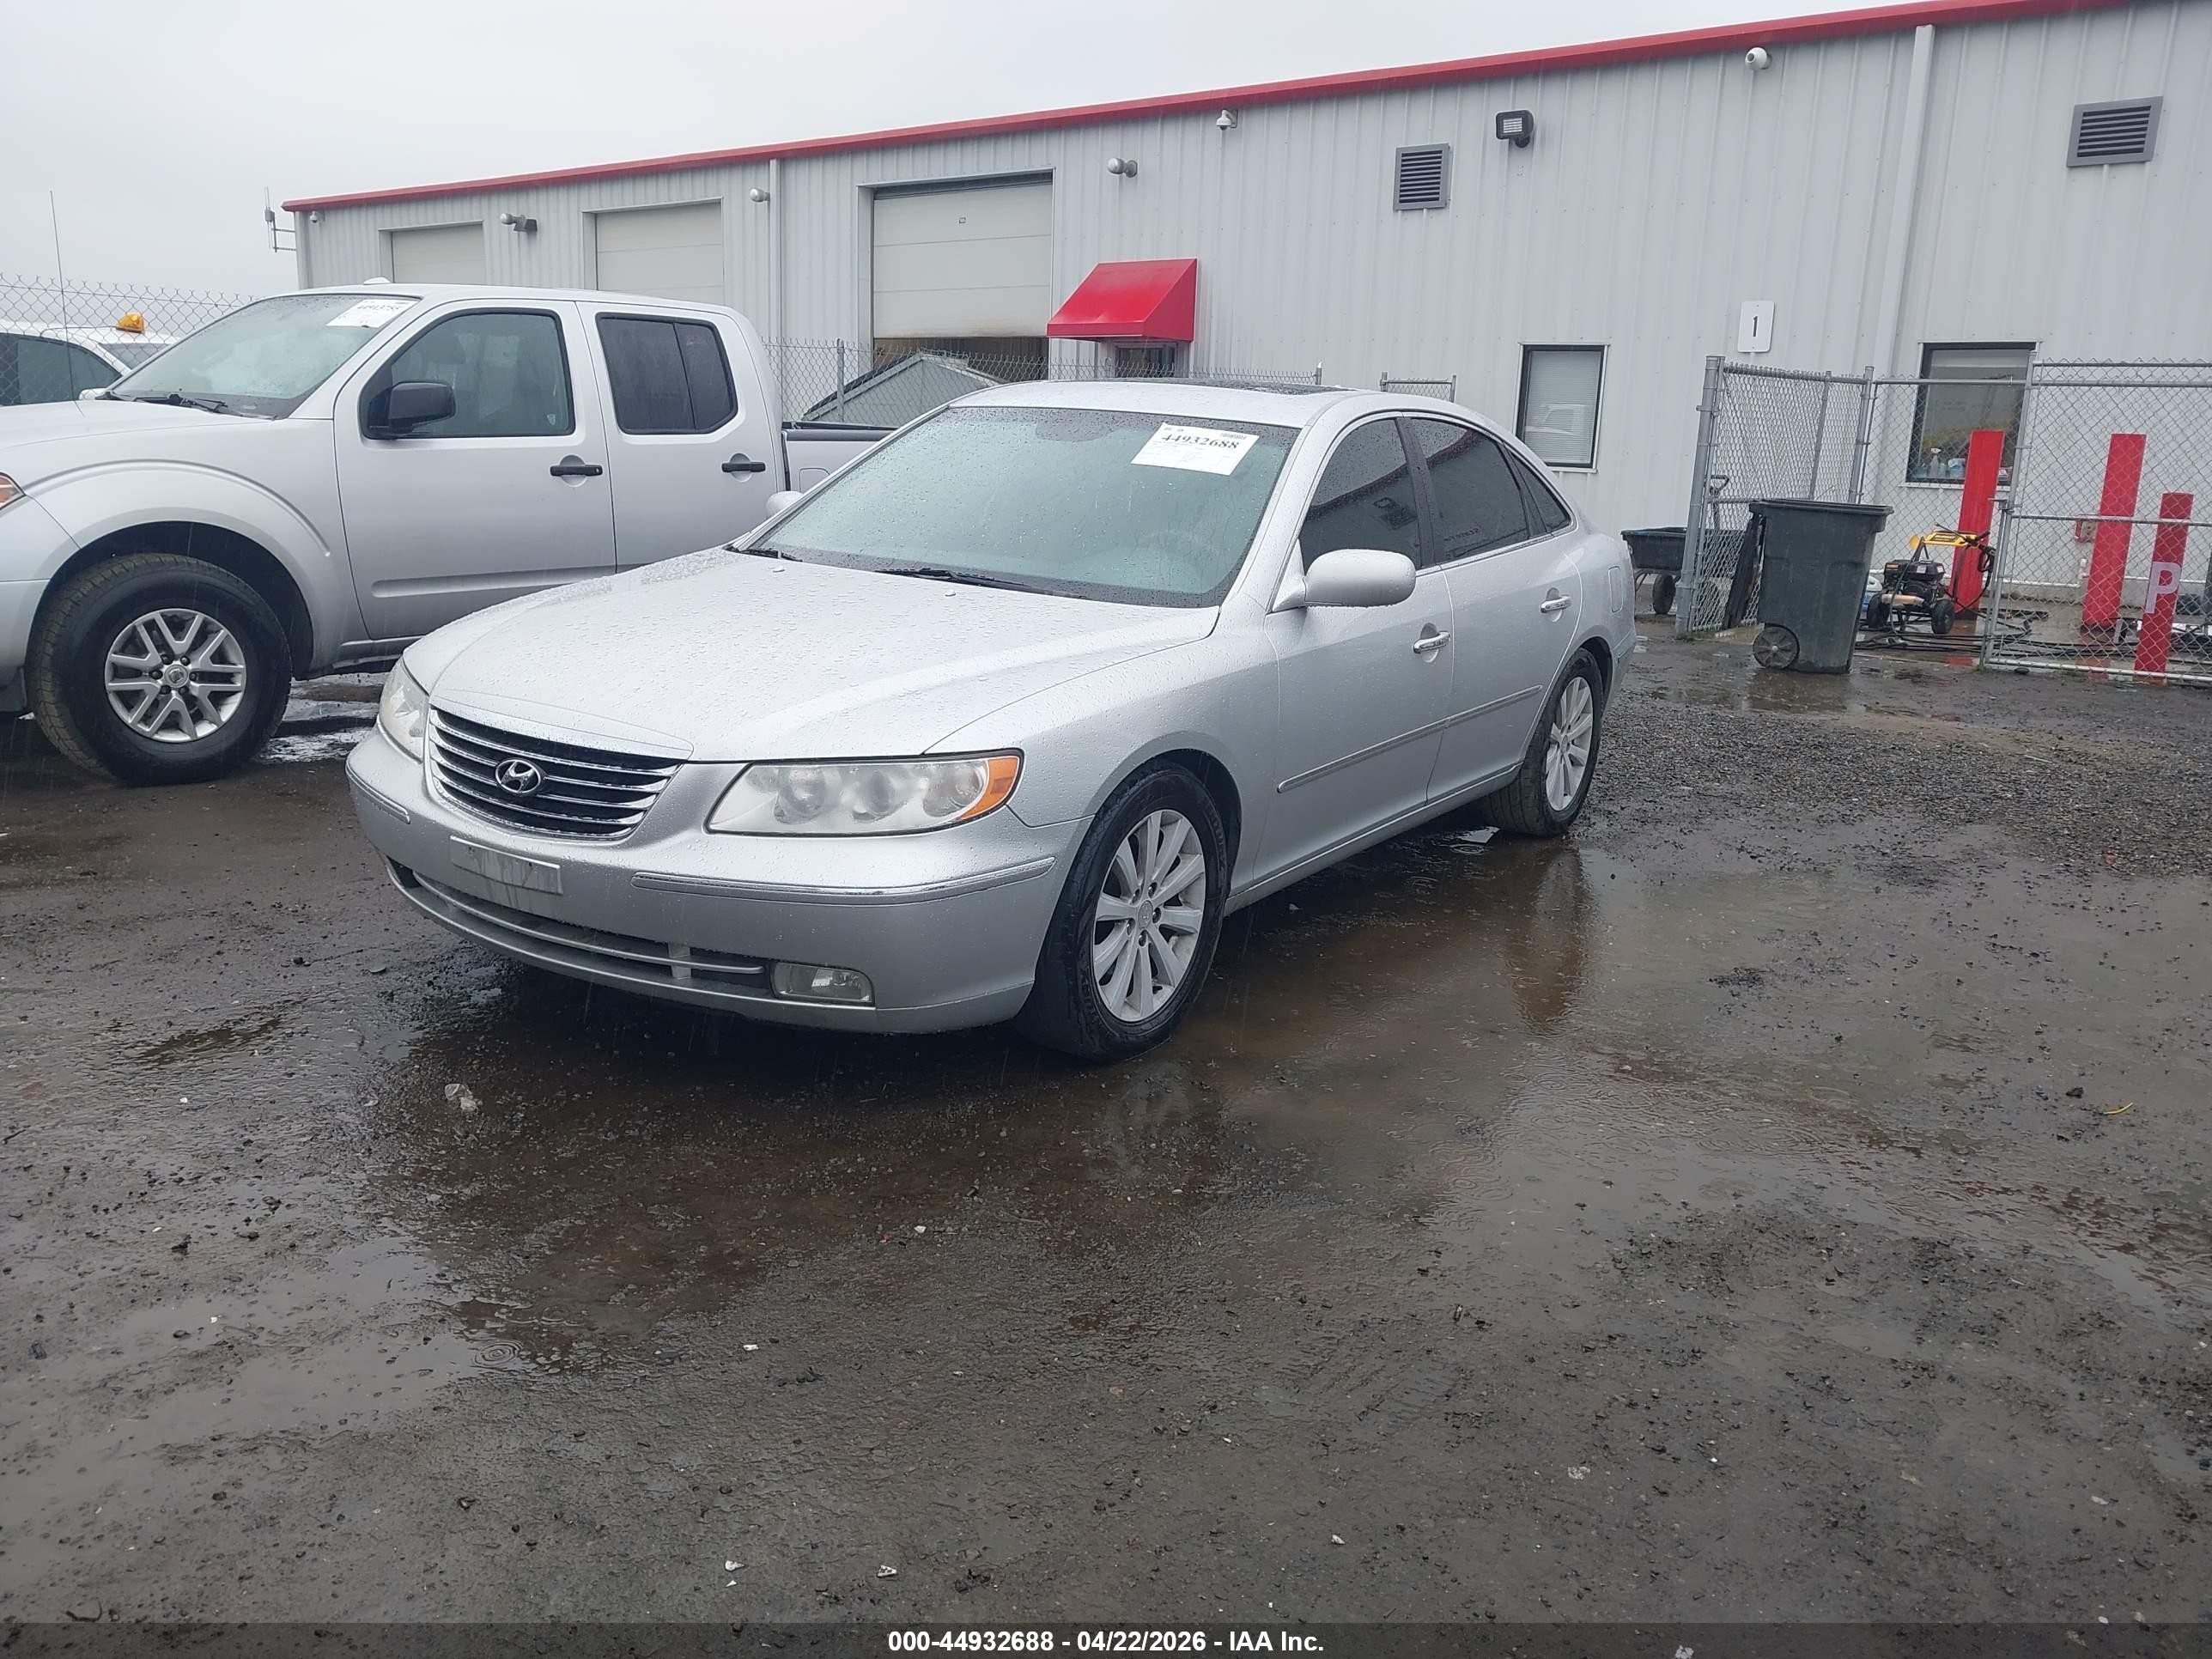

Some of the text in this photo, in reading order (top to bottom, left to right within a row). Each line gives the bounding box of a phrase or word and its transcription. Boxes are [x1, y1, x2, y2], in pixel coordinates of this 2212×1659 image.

[1753, 315, 1759, 337] 1
[1161, 433, 1240, 450] 44932688
[2145, 561, 2182, 614] P
